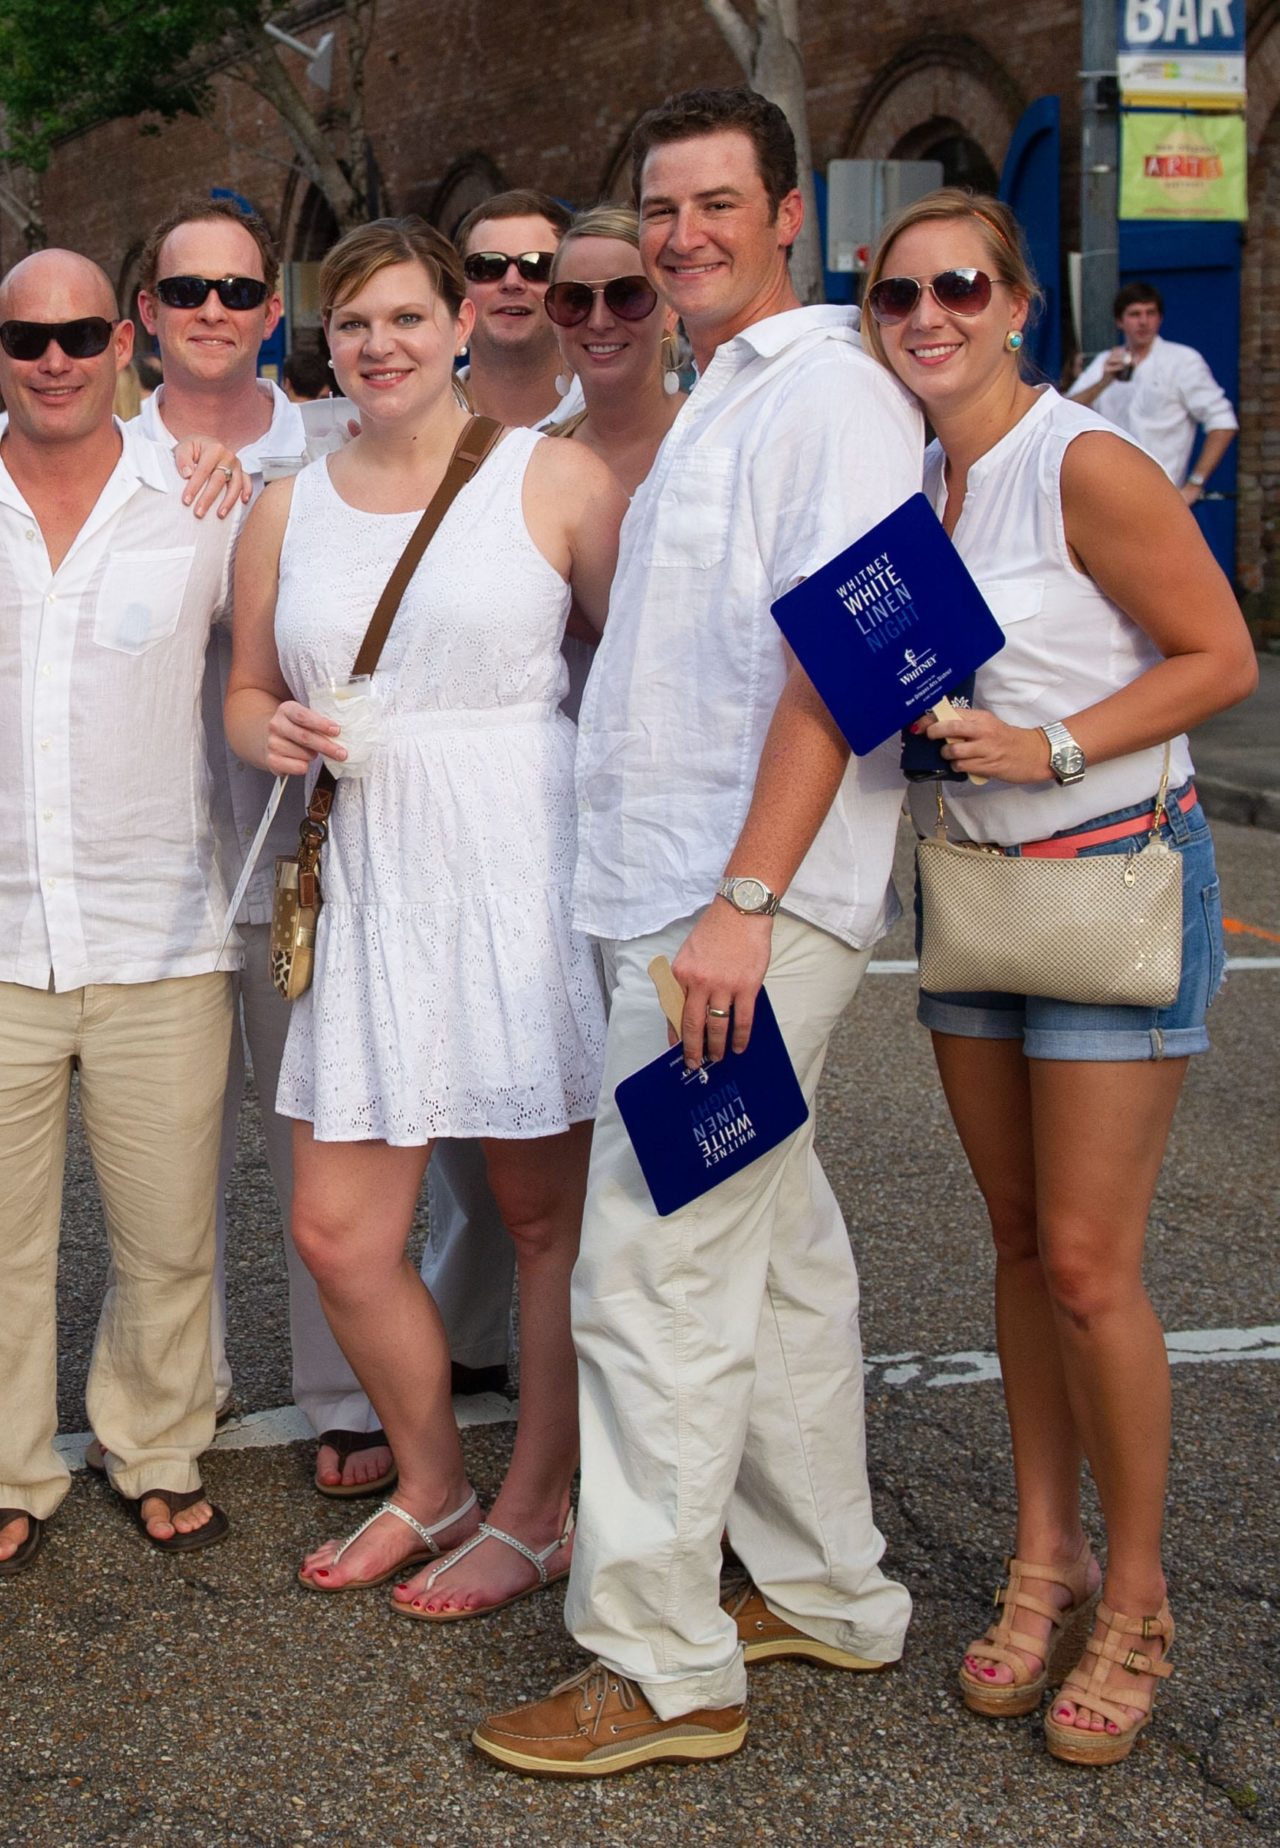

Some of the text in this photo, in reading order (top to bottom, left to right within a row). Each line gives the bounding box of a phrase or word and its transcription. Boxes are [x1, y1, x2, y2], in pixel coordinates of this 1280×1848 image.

[1124, 0, 1236, 45] BAR
[1146, 157, 1219, 177] ARTS
[836, 552, 890, 598] WHITNEY
[843, 564, 902, 616] WHITE
[856, 583, 912, 635] LINEN
[866, 602, 919, 653] NIGHT
[900, 656, 937, 685] WHITNEY
[693, 1096, 745, 1142] LINEN
[698, 1113, 752, 1158] WHITE
[705, 1128, 757, 1168] WHITNEY
